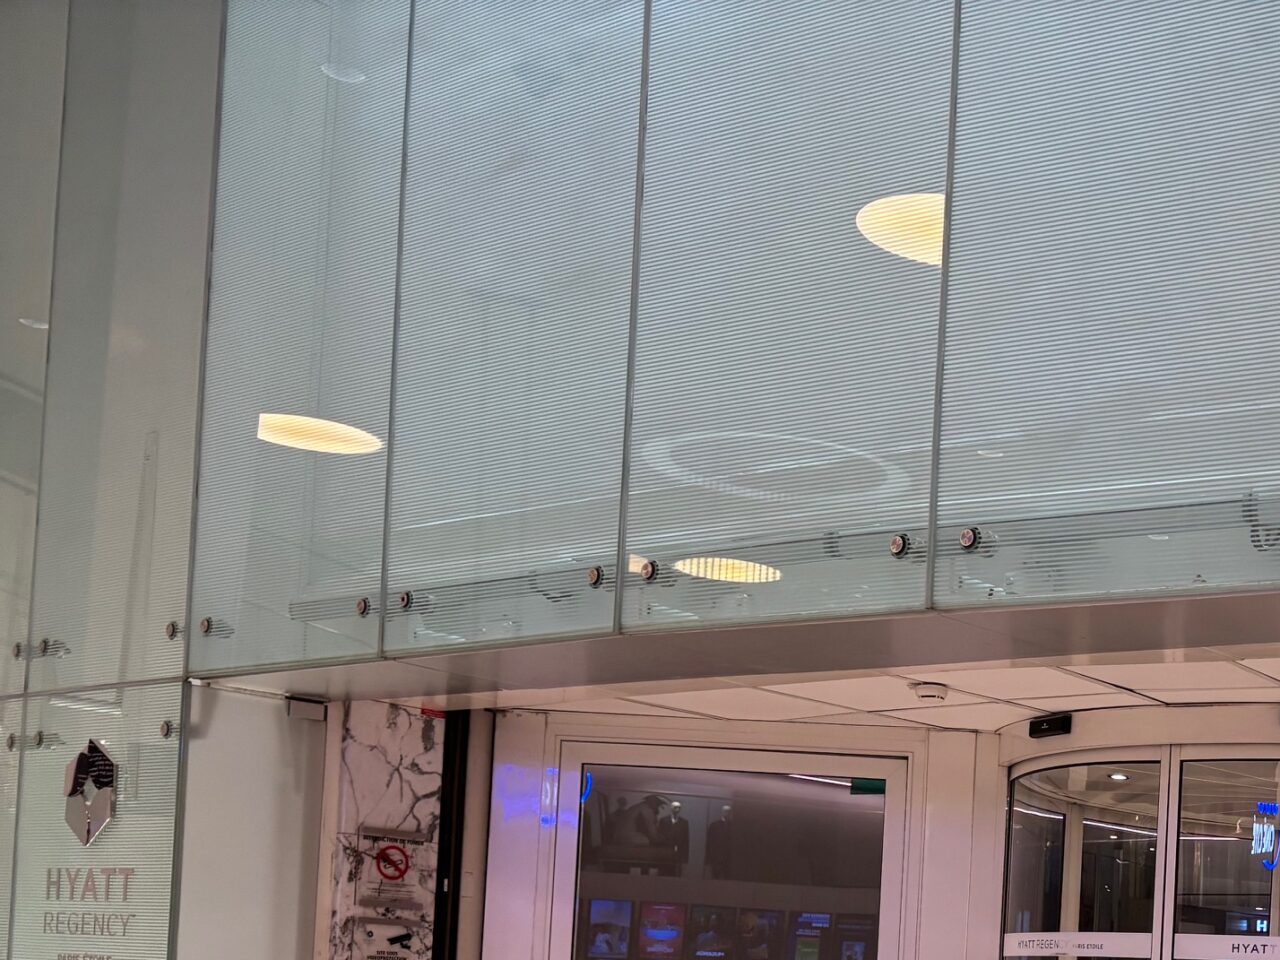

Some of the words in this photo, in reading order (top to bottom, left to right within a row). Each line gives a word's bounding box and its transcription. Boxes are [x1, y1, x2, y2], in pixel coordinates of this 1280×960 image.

[46, 867, 135, 901] HYATT
[43, 911, 132, 936] REGENCY
[1036, 939, 1067, 950] REGEN
